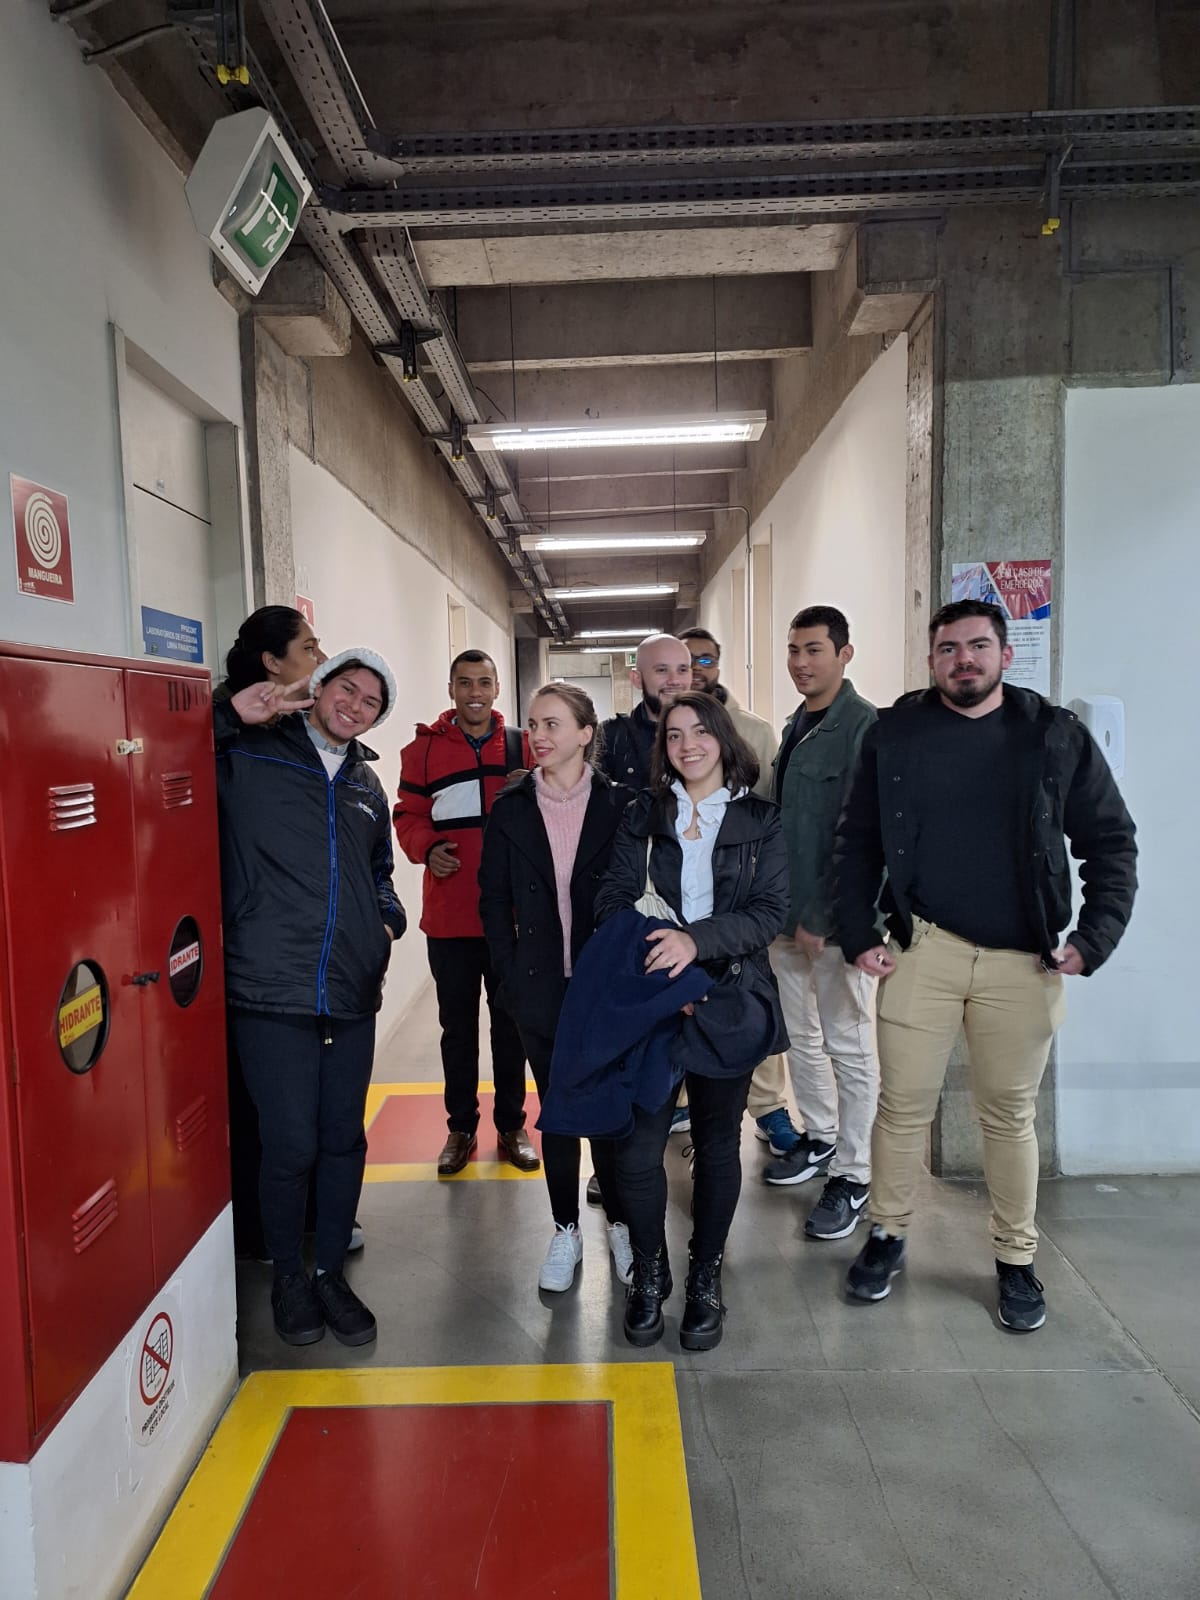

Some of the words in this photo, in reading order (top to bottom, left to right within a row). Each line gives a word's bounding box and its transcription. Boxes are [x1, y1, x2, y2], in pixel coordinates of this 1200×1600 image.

[28, 567, 63, 585] MANGUEIRA
[1013, 567, 1033, 577] CASO
[1034, 566, 1045, 577] DE
[60, 995, 101, 1035] HIDRANTE
